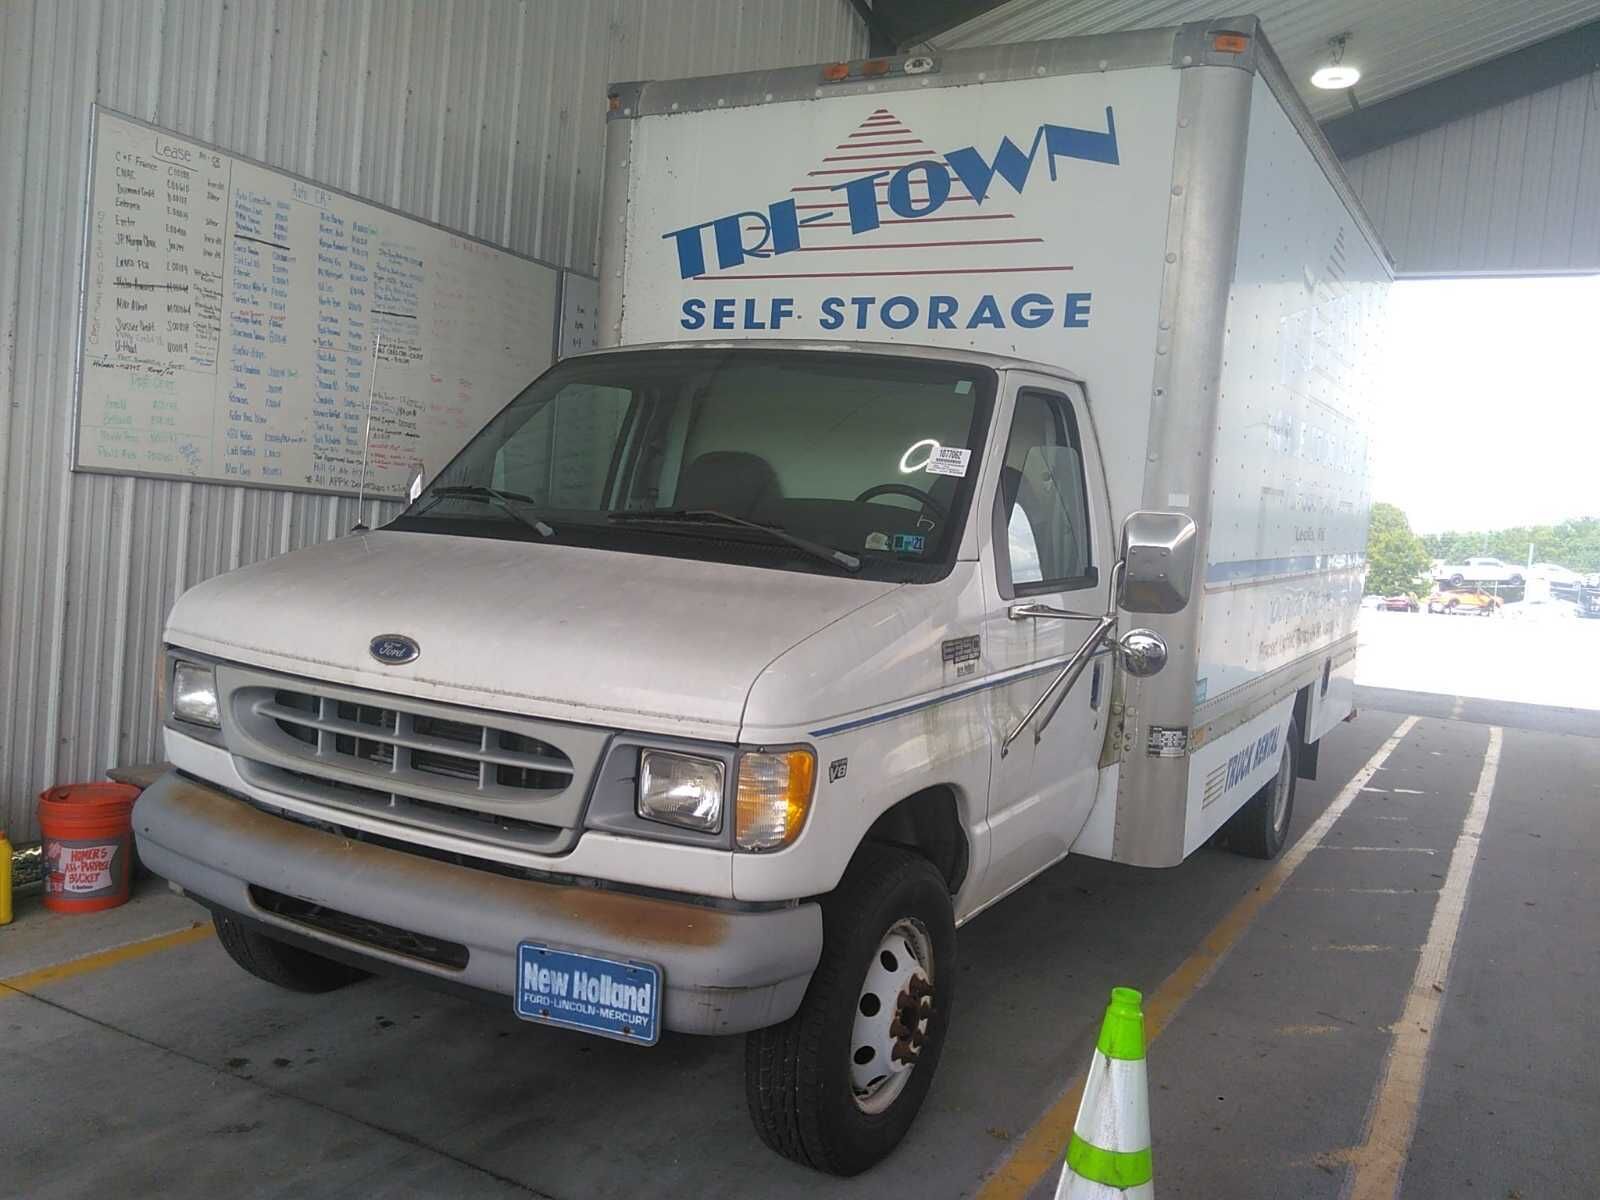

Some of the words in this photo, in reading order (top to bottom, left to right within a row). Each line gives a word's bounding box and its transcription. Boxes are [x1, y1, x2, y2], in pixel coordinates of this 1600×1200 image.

[155, 136, 192, 162] Lease
[662, 106, 1119, 279] TRI-TOWN
[680, 297, 793, 329] SELF
[820, 294, 1092, 329] STORAGE
[379, 641, 408, 657] Ford
[829, 765, 847, 783] V8
[1224, 742, 1256, 793] TRUCK
[69, 873, 101, 884] BUCKET
[524, 961, 569, 997] New
[573, 970, 650, 1015] Holland
